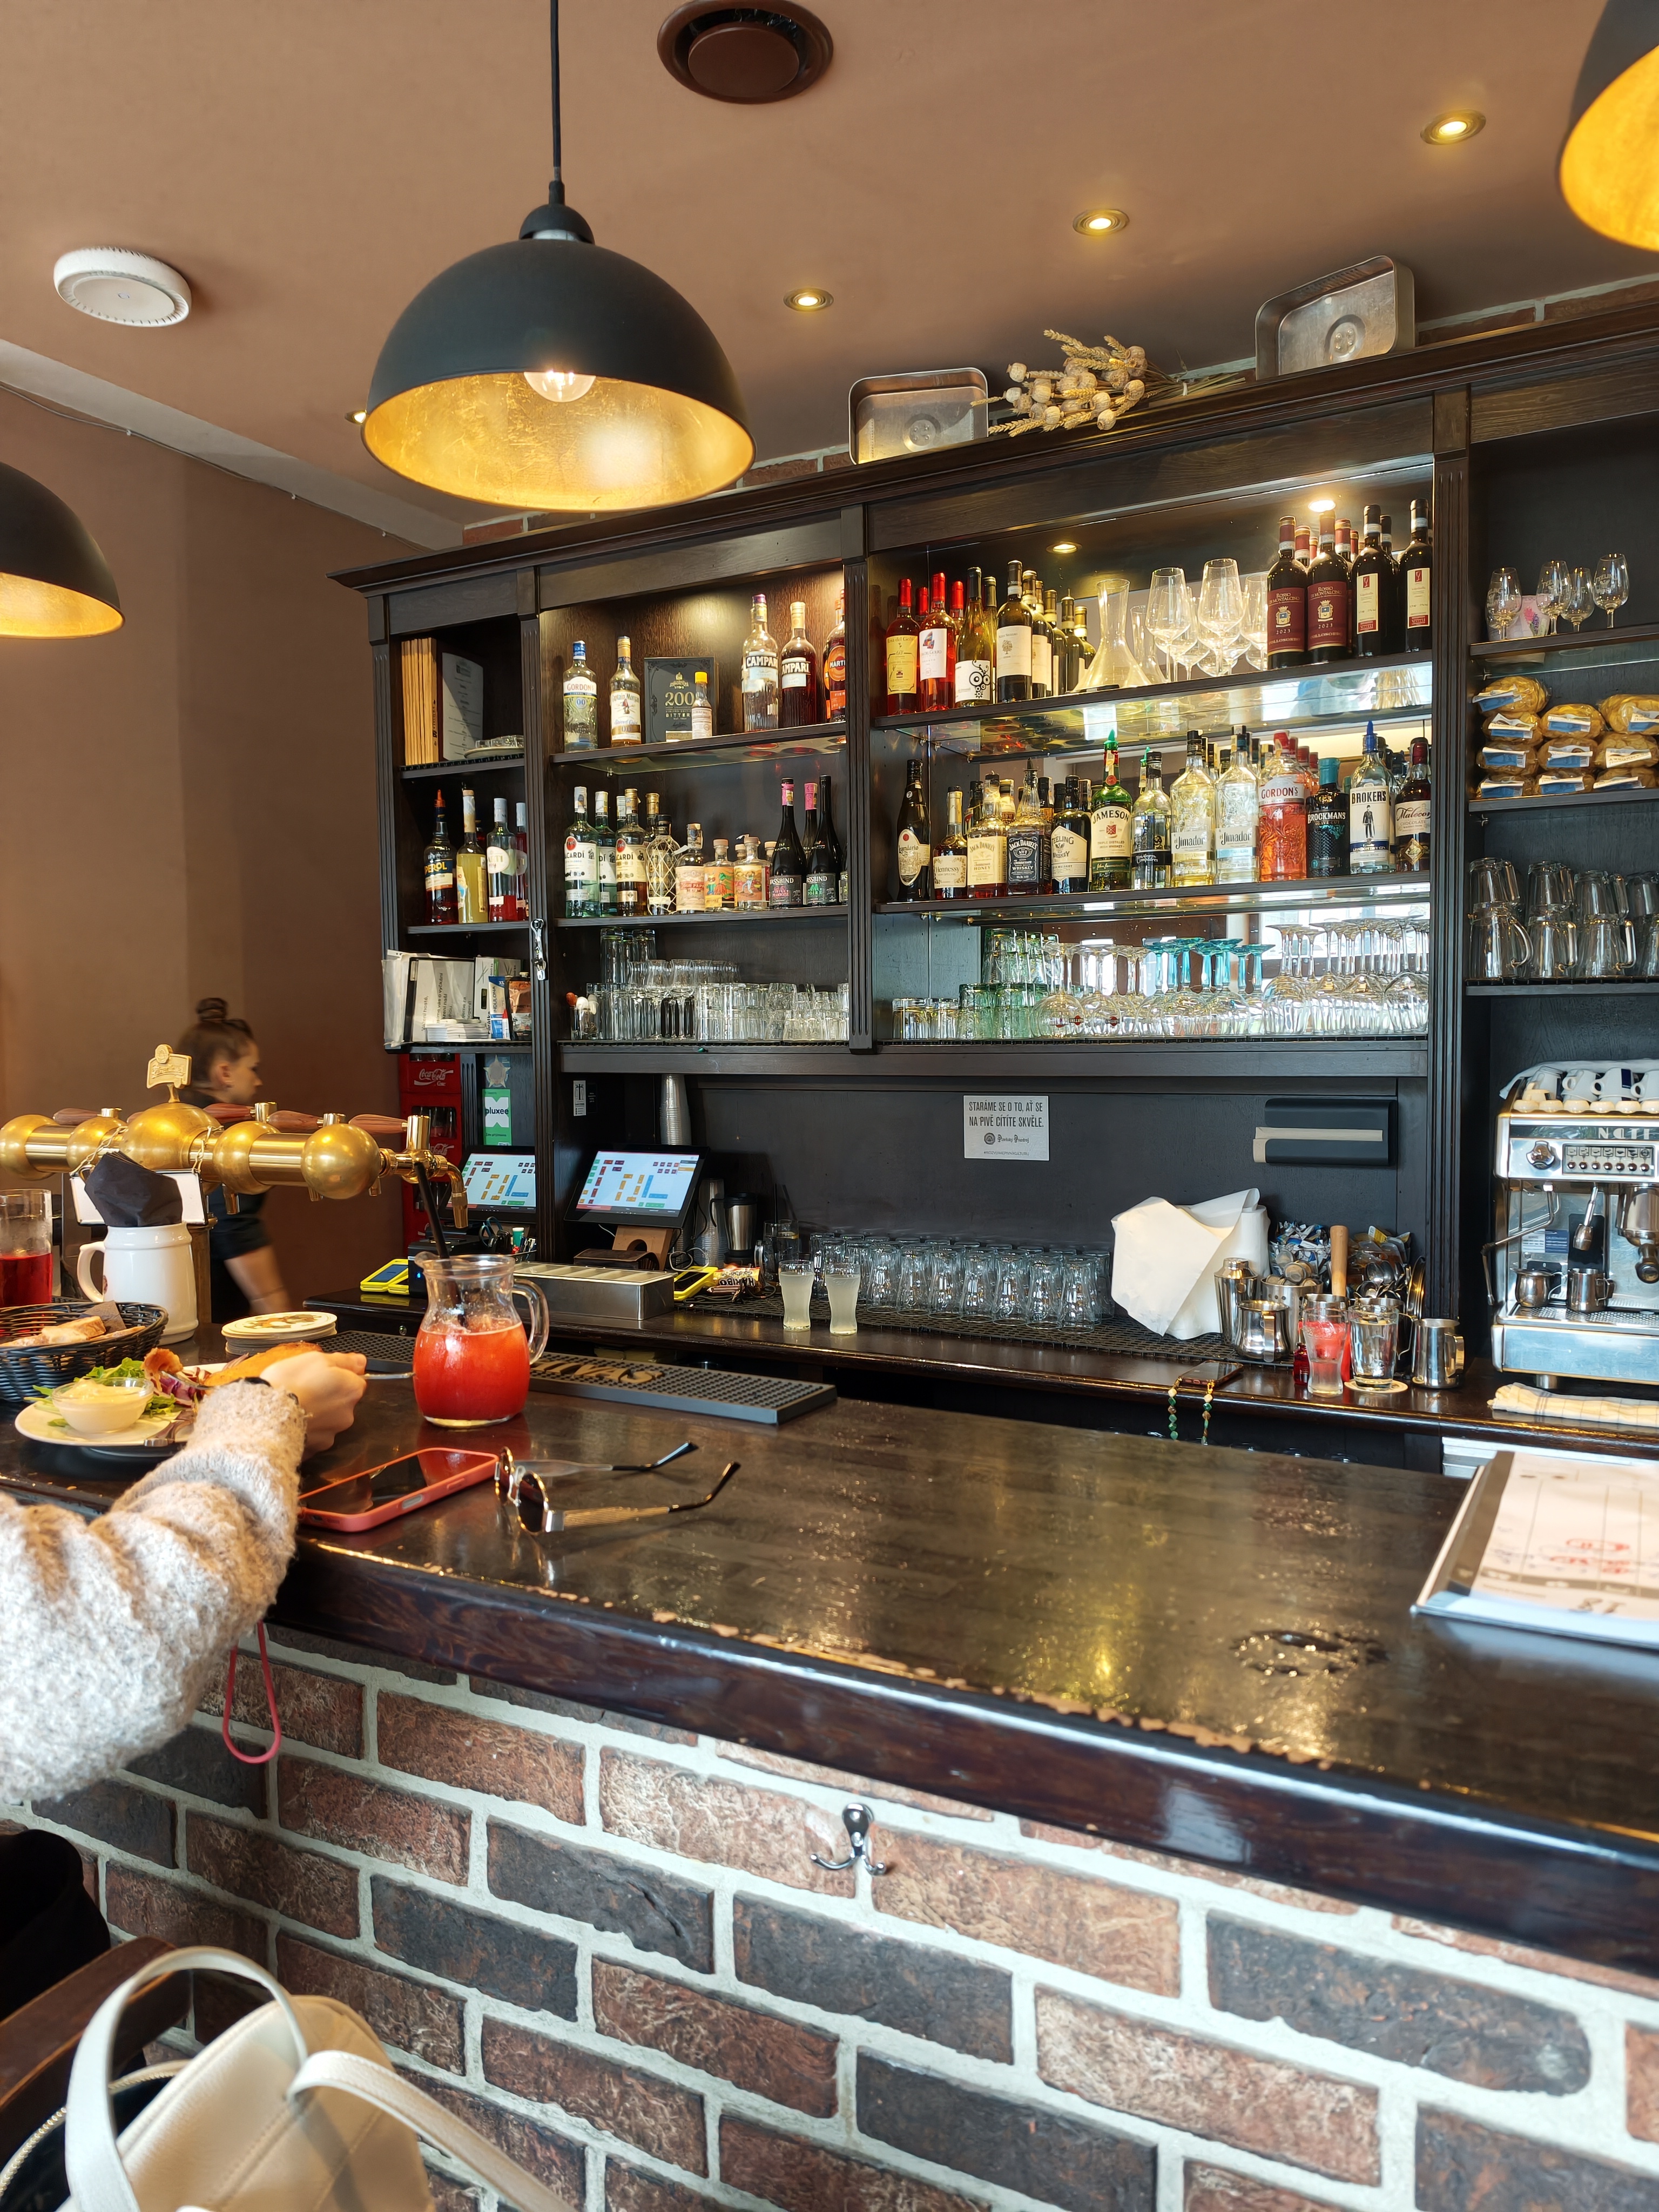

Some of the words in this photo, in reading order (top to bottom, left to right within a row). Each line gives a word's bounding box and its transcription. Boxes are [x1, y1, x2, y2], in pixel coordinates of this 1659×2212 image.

[665, 692, 695, 706] 200
[1261, 786, 1298, 799] GORDON'S
[1352, 791, 1386, 804] BROKER'S
[1092, 810, 1129, 824] JAMESON
[1307, 812, 1346, 824] BROCKMANS
[1009, 841, 1020, 851] JACK
[969, 1100, 997, 1111] STARÁME
[999, 1102, 1006, 1111] SE
[1008, 1102, 1012, 1111] O
[1014, 1102, 1024, 1112] TO,
[1036, 1102, 1043, 1112] SE
[969, 1116, 978, 1127] NA
[980, 1114, 994, 1127] PIVĚ
[996, 1114, 1016, 1127] CÍTÍTE
[1019, 1115, 1044, 1128] SKVĚLE.
